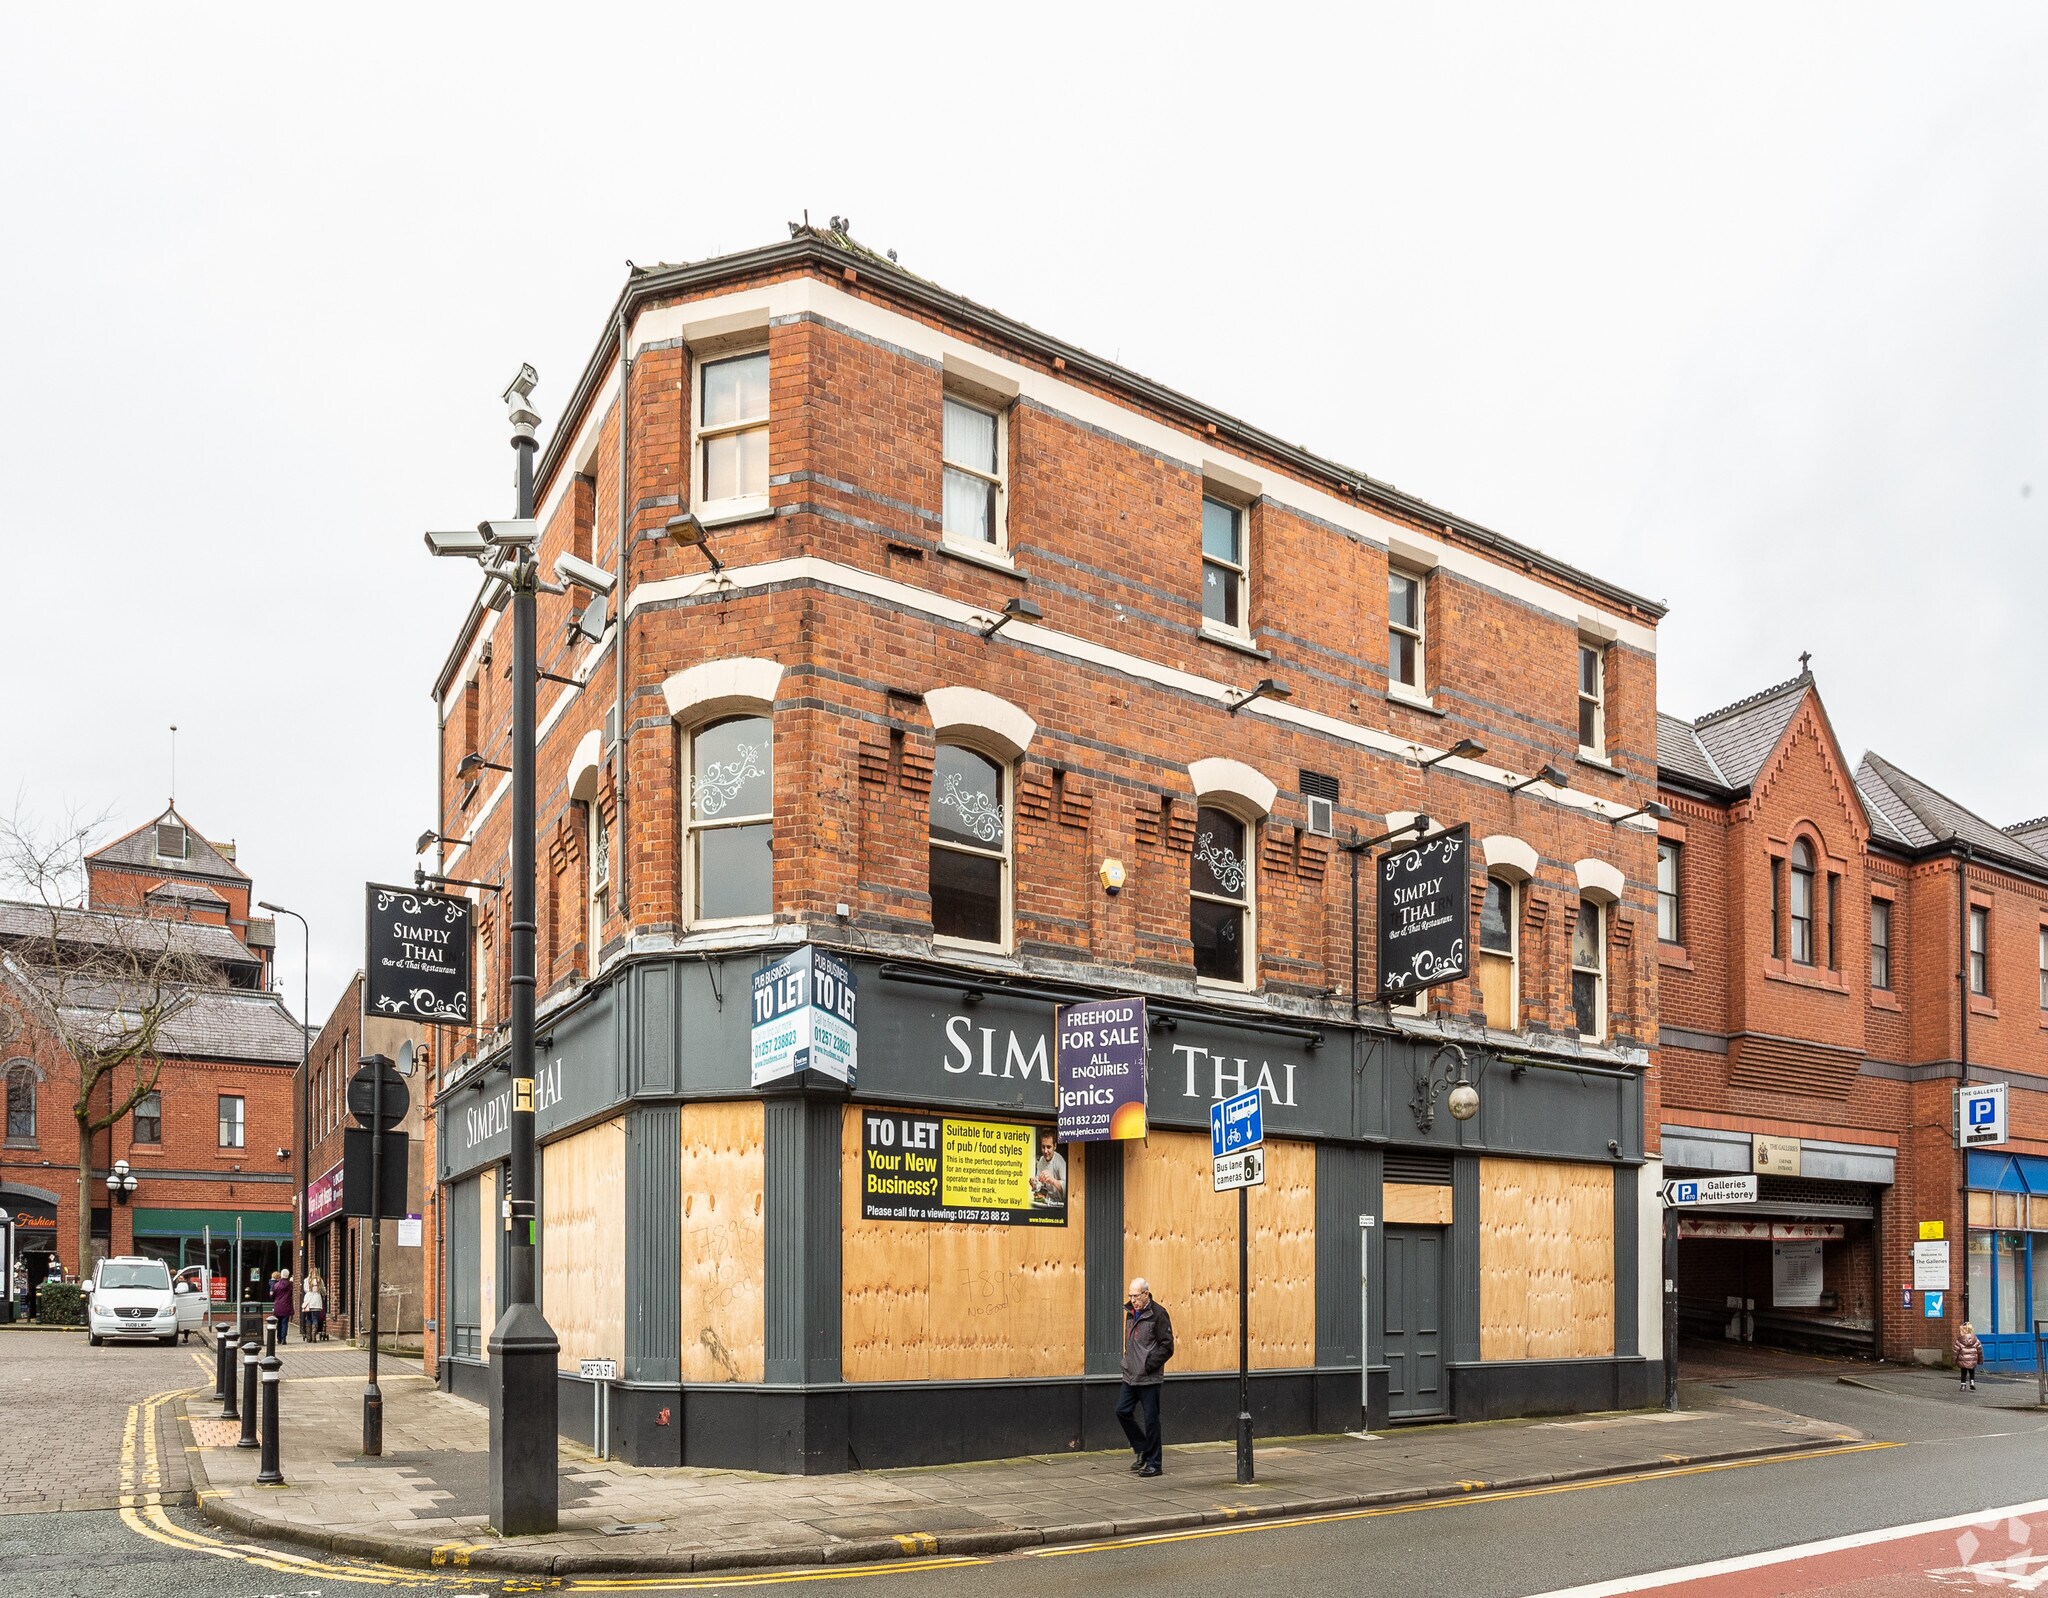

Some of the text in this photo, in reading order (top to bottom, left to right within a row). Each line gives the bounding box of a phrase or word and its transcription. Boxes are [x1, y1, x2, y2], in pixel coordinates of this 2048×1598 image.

[1394, 876, 1443, 906] SIMPLY
[1400, 901, 1436, 924] THAI
[394, 922, 451, 944] SIMPLY
[1389, 930, 1400, 940] Bar
[1408, 922, 1421, 934] Thai
[1421, 915, 1453, 930] Restaurant
[402, 942, 444, 962] THAI
[382, 958, 396, 966] Bar
[405, 960, 421, 970] Thai
[421, 962, 456, 974] Restaurant
[754, 961, 791, 989] PUB BUSINESS
[814, 953, 848, 984] PUB BUSINESS
[755, 968, 806, 1022] TO LET
[814, 969, 856, 1024] TO LET
[1068, 1008, 1133, 1027] FREEHOLD
[755, 1030, 796, 1058] 01257 238823
[815, 1026, 850, 1056] 01257 238823
[1062, 1027, 1139, 1050] FOR SALE
[944, 1016, 1298, 1106] SIM THAI
[1090, 1053, 1110, 1065] ALL
[1072, 1063, 1129, 1078] ENQUIRIES
[467, 1058, 563, 1148] SIMPLY HAI
[1059, 1084, 1114, 1113] jenics
[1059, 1114, 1110, 1126] 0161 832 2201
[1976, 1101, 1992, 1123] P
[867, 1118, 939, 1149] TO LET
[947, 1124, 1030, 1144] Suitable for a variety
[1059, 1127, 1109, 1138] www.jenics.com
[947, 1140, 955, 1150] of
[958, 1141, 972, 1153] pub
[979, 1142, 996, 1153] food
[999, 1144, 1022, 1156] styles
[1778, 1144, 1799, 1152] GALLERIES
[867, 1150, 937, 1173] Your New
[994, 1160, 1023, 1168] opportunity
[1216, 1159, 1242, 1172] Bus lane
[963, 1167, 994, 1175] experienced
[996, 1169, 1023, 1177] dining-pub
[1216, 1173, 1242, 1185] cameras
[868, 1174, 938, 1196] Business?
[1682, 1185, 1692, 1200] P
[1708, 1180, 1746, 1190] Galleries
[1010, 1198, 1022, 1206] Way!
[1700, 1190, 1754, 1201] Multi-storey
[15, 1212, 55, 1227] Fashion
[867, 1205, 1010, 1221] Please call for a viewing: 01257 23 88 23
[581, 1364, 610, 1376] MARSEN ST
